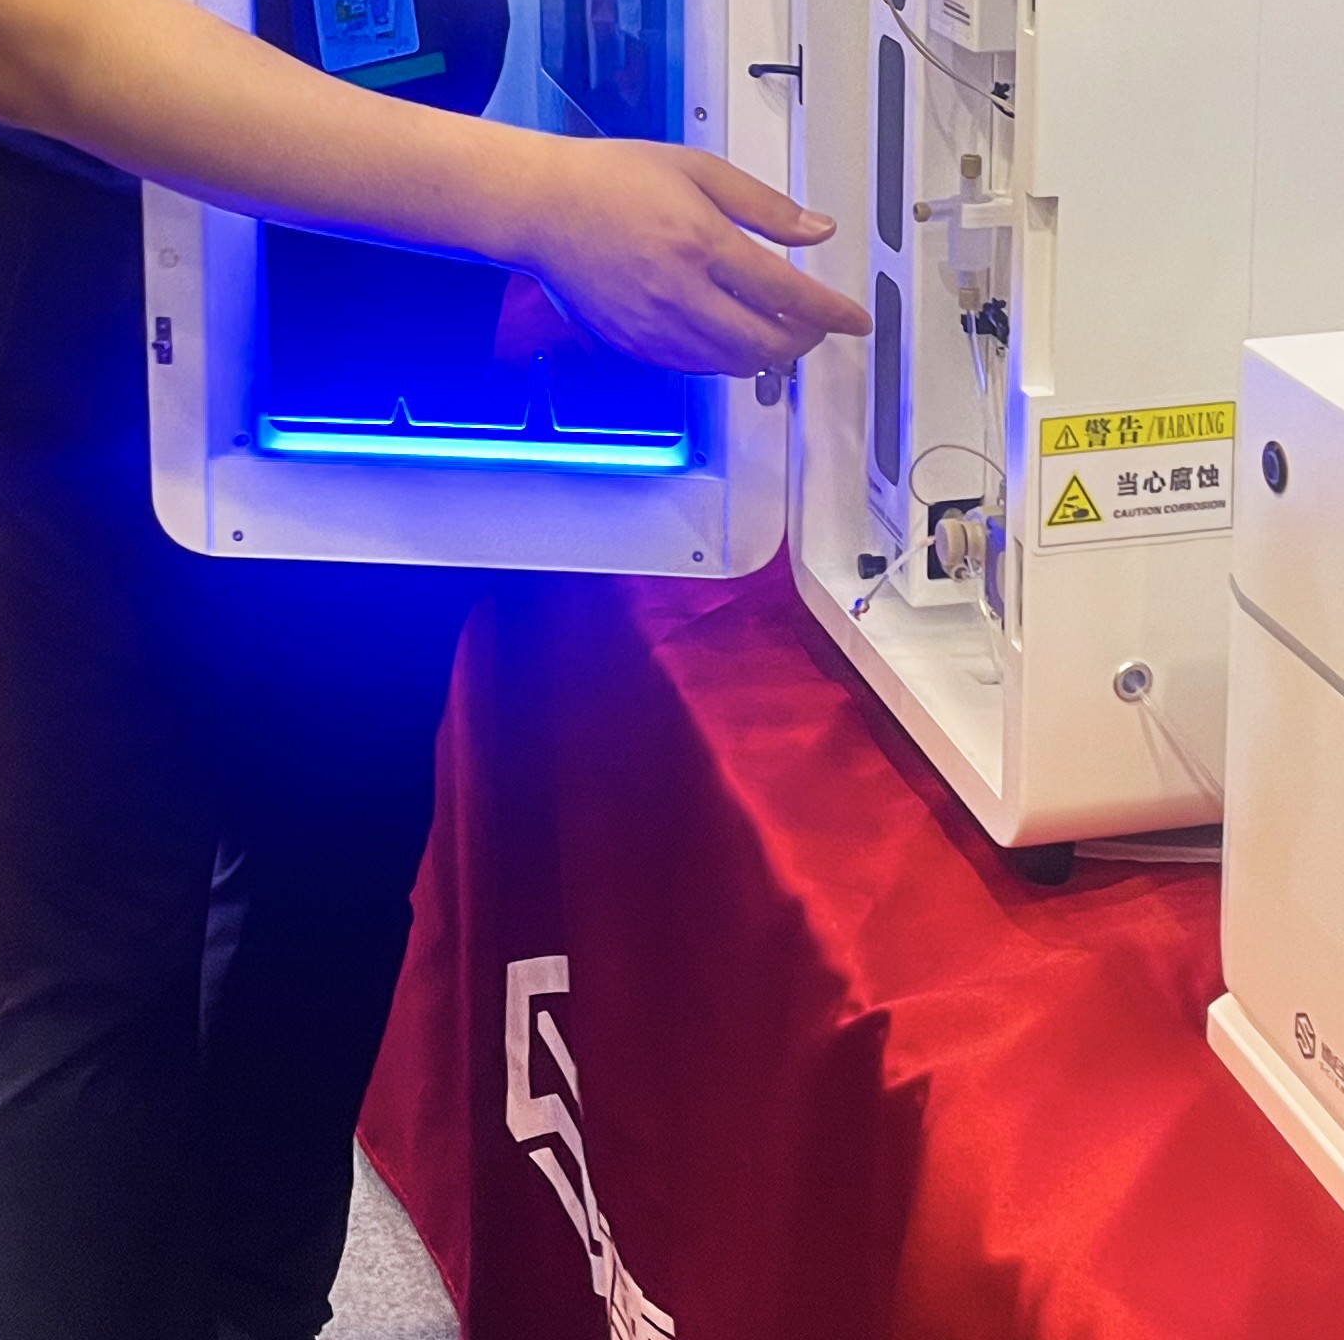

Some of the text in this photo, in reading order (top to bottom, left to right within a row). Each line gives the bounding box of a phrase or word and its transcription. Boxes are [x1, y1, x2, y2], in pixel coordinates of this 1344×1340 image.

[1117, 464, 1220, 496] 当心腐蚀
[1113, 506, 1162, 519] CAUTION
